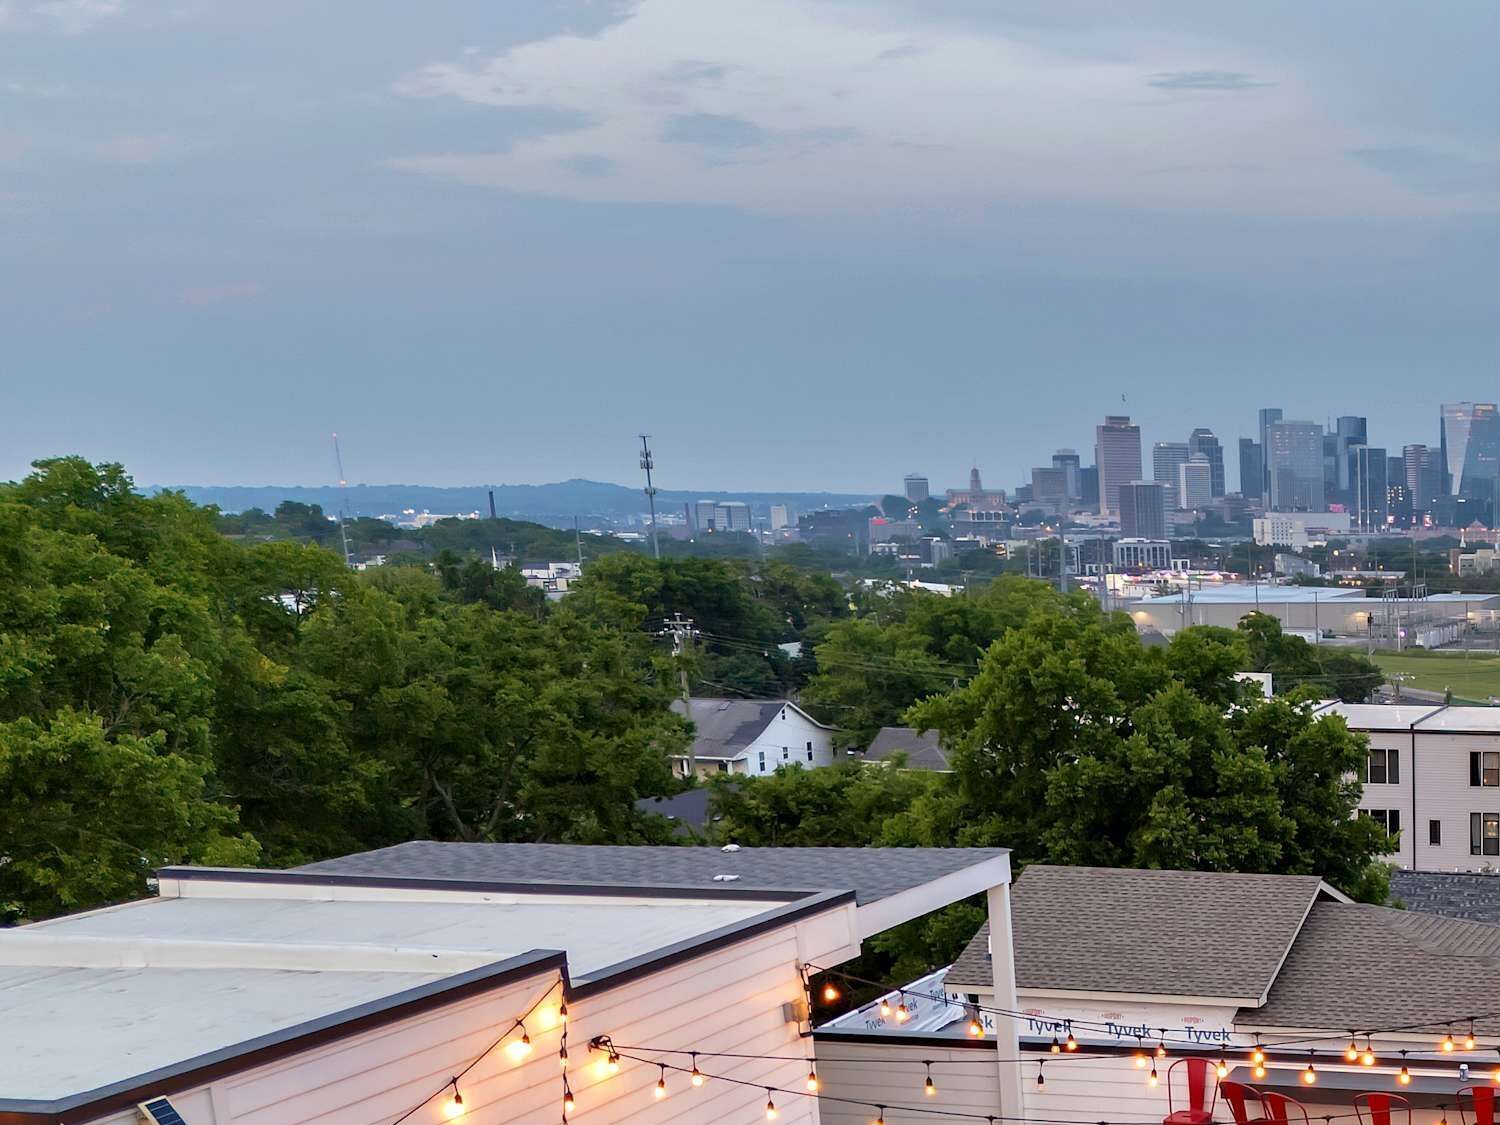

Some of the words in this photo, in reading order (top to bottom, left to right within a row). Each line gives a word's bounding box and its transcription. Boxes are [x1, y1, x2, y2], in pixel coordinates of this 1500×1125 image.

[1028, 1019, 1071, 1035] Tyvek
[1105, 1022, 1151, 1039] Tyvek
[1184, 1026, 1231, 1043] Tyvek
